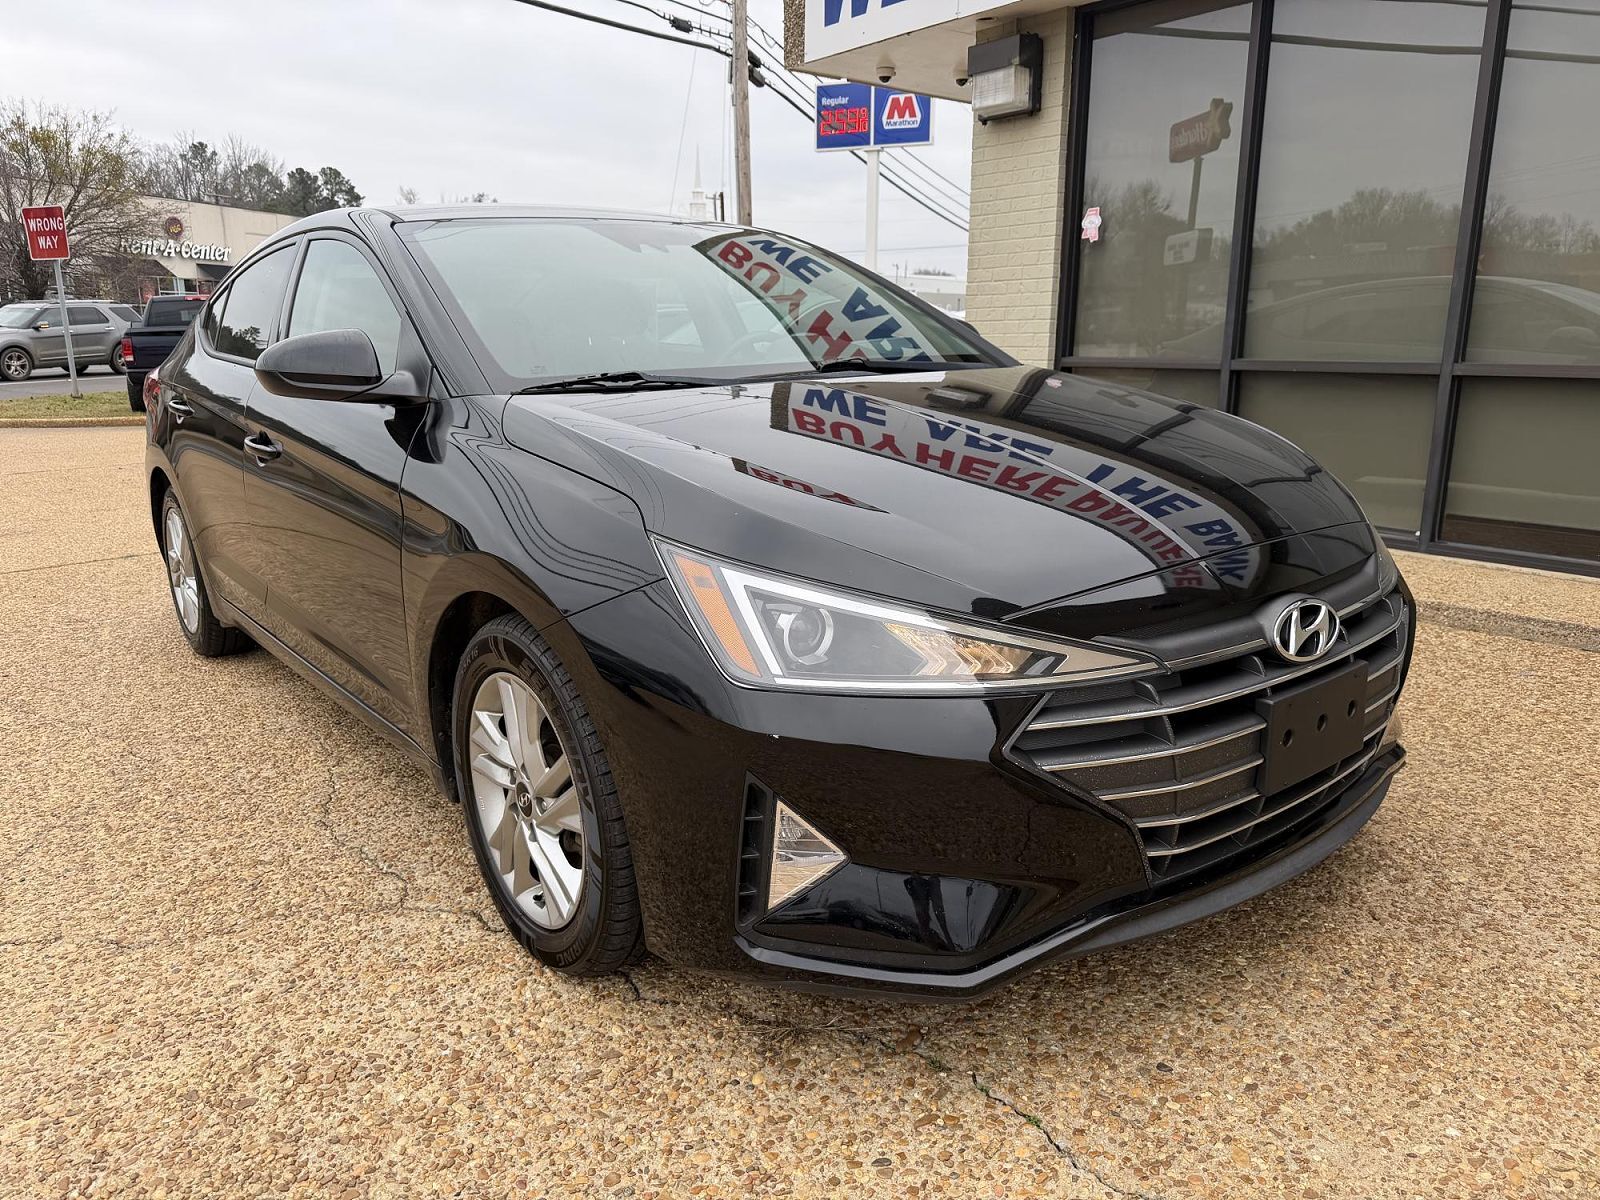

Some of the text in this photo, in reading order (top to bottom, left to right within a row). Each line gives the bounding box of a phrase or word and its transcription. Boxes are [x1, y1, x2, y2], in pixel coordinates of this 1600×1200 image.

[821, 96, 850, 107] Regular
[884, 119, 918, 128] Marathon
[27, 216, 64, 232] WRONG
[37, 235, 59, 250] WAY
